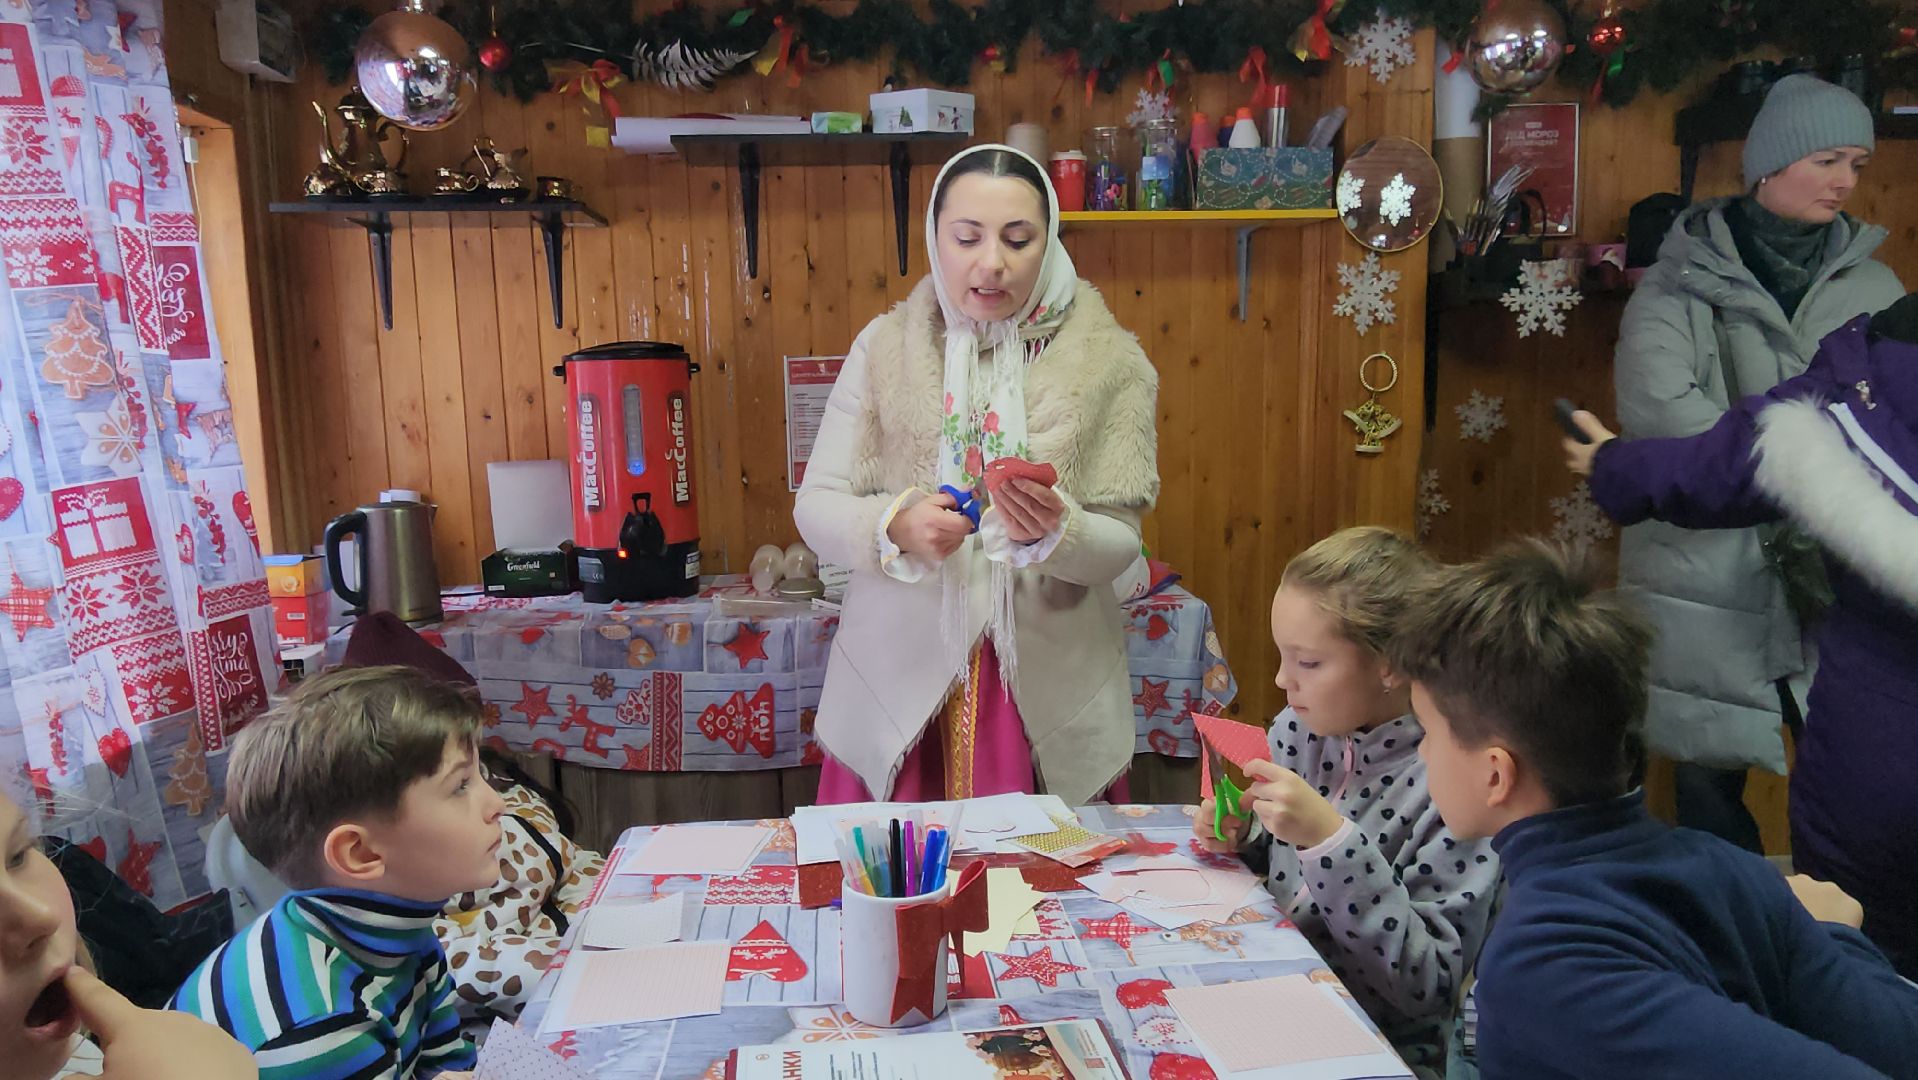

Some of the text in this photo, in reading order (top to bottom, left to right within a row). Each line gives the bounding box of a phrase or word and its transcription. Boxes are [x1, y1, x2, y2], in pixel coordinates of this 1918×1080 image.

[580, 400, 600, 506] MacCoffee
[671, 398, 689, 502] MacCoffee
[783, 1050, 801, 1080] НКИ
